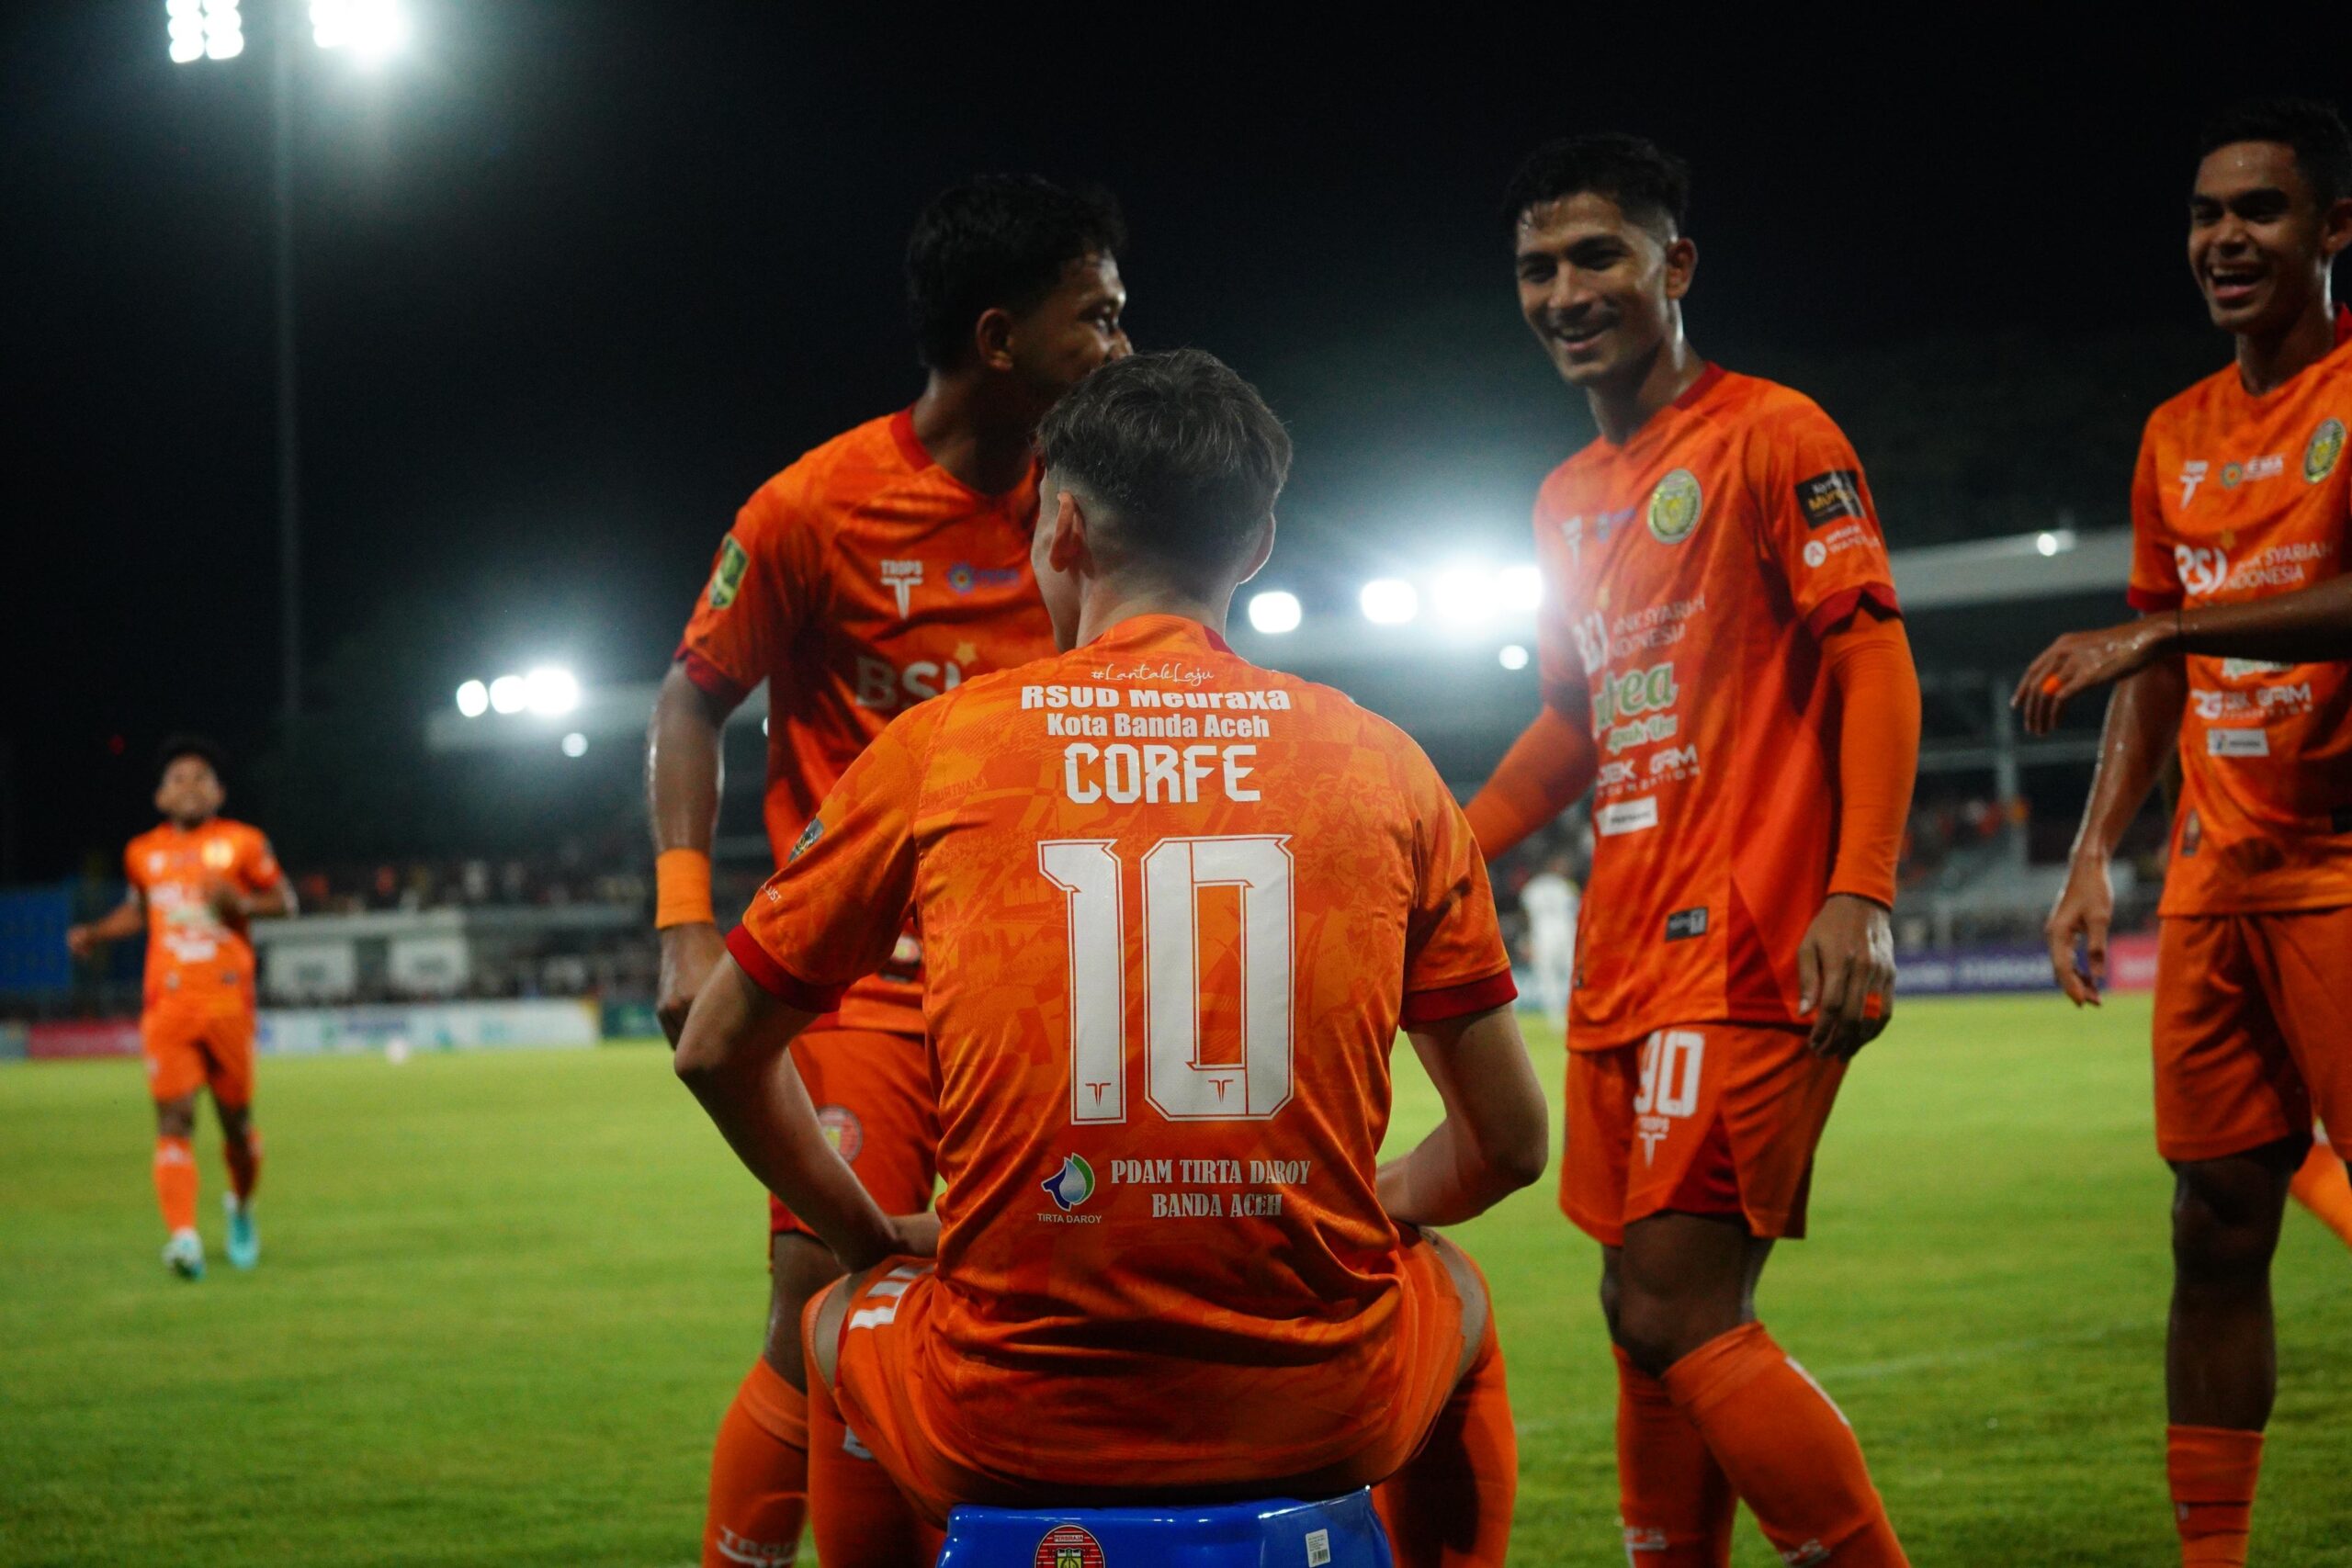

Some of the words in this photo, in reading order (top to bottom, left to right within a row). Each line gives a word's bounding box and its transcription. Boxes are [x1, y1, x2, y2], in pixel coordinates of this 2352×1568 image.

[1021, 685, 1120, 709] RSUD
[1130, 688, 1291, 710] Meuraxa
[1046, 713, 1107, 736] Kota
[1114, 713, 1198, 738] Banda
[1204, 715, 1270, 738] Aceh
[1064, 742, 1261, 804] CORFE
[1037, 834, 1295, 1125] 10
[1110, 1159, 1174, 1184] PDAM
[1179, 1159, 1242, 1184] TIRTA
[1250, 1160, 1311, 1185] DAROY
[1151, 1193, 1223, 1218] BANDA
[1230, 1193, 1283, 1218] ACEH
[1037, 1213, 1064, 1224] TIRTA
[1066, 1214, 1102, 1224] DAROY
